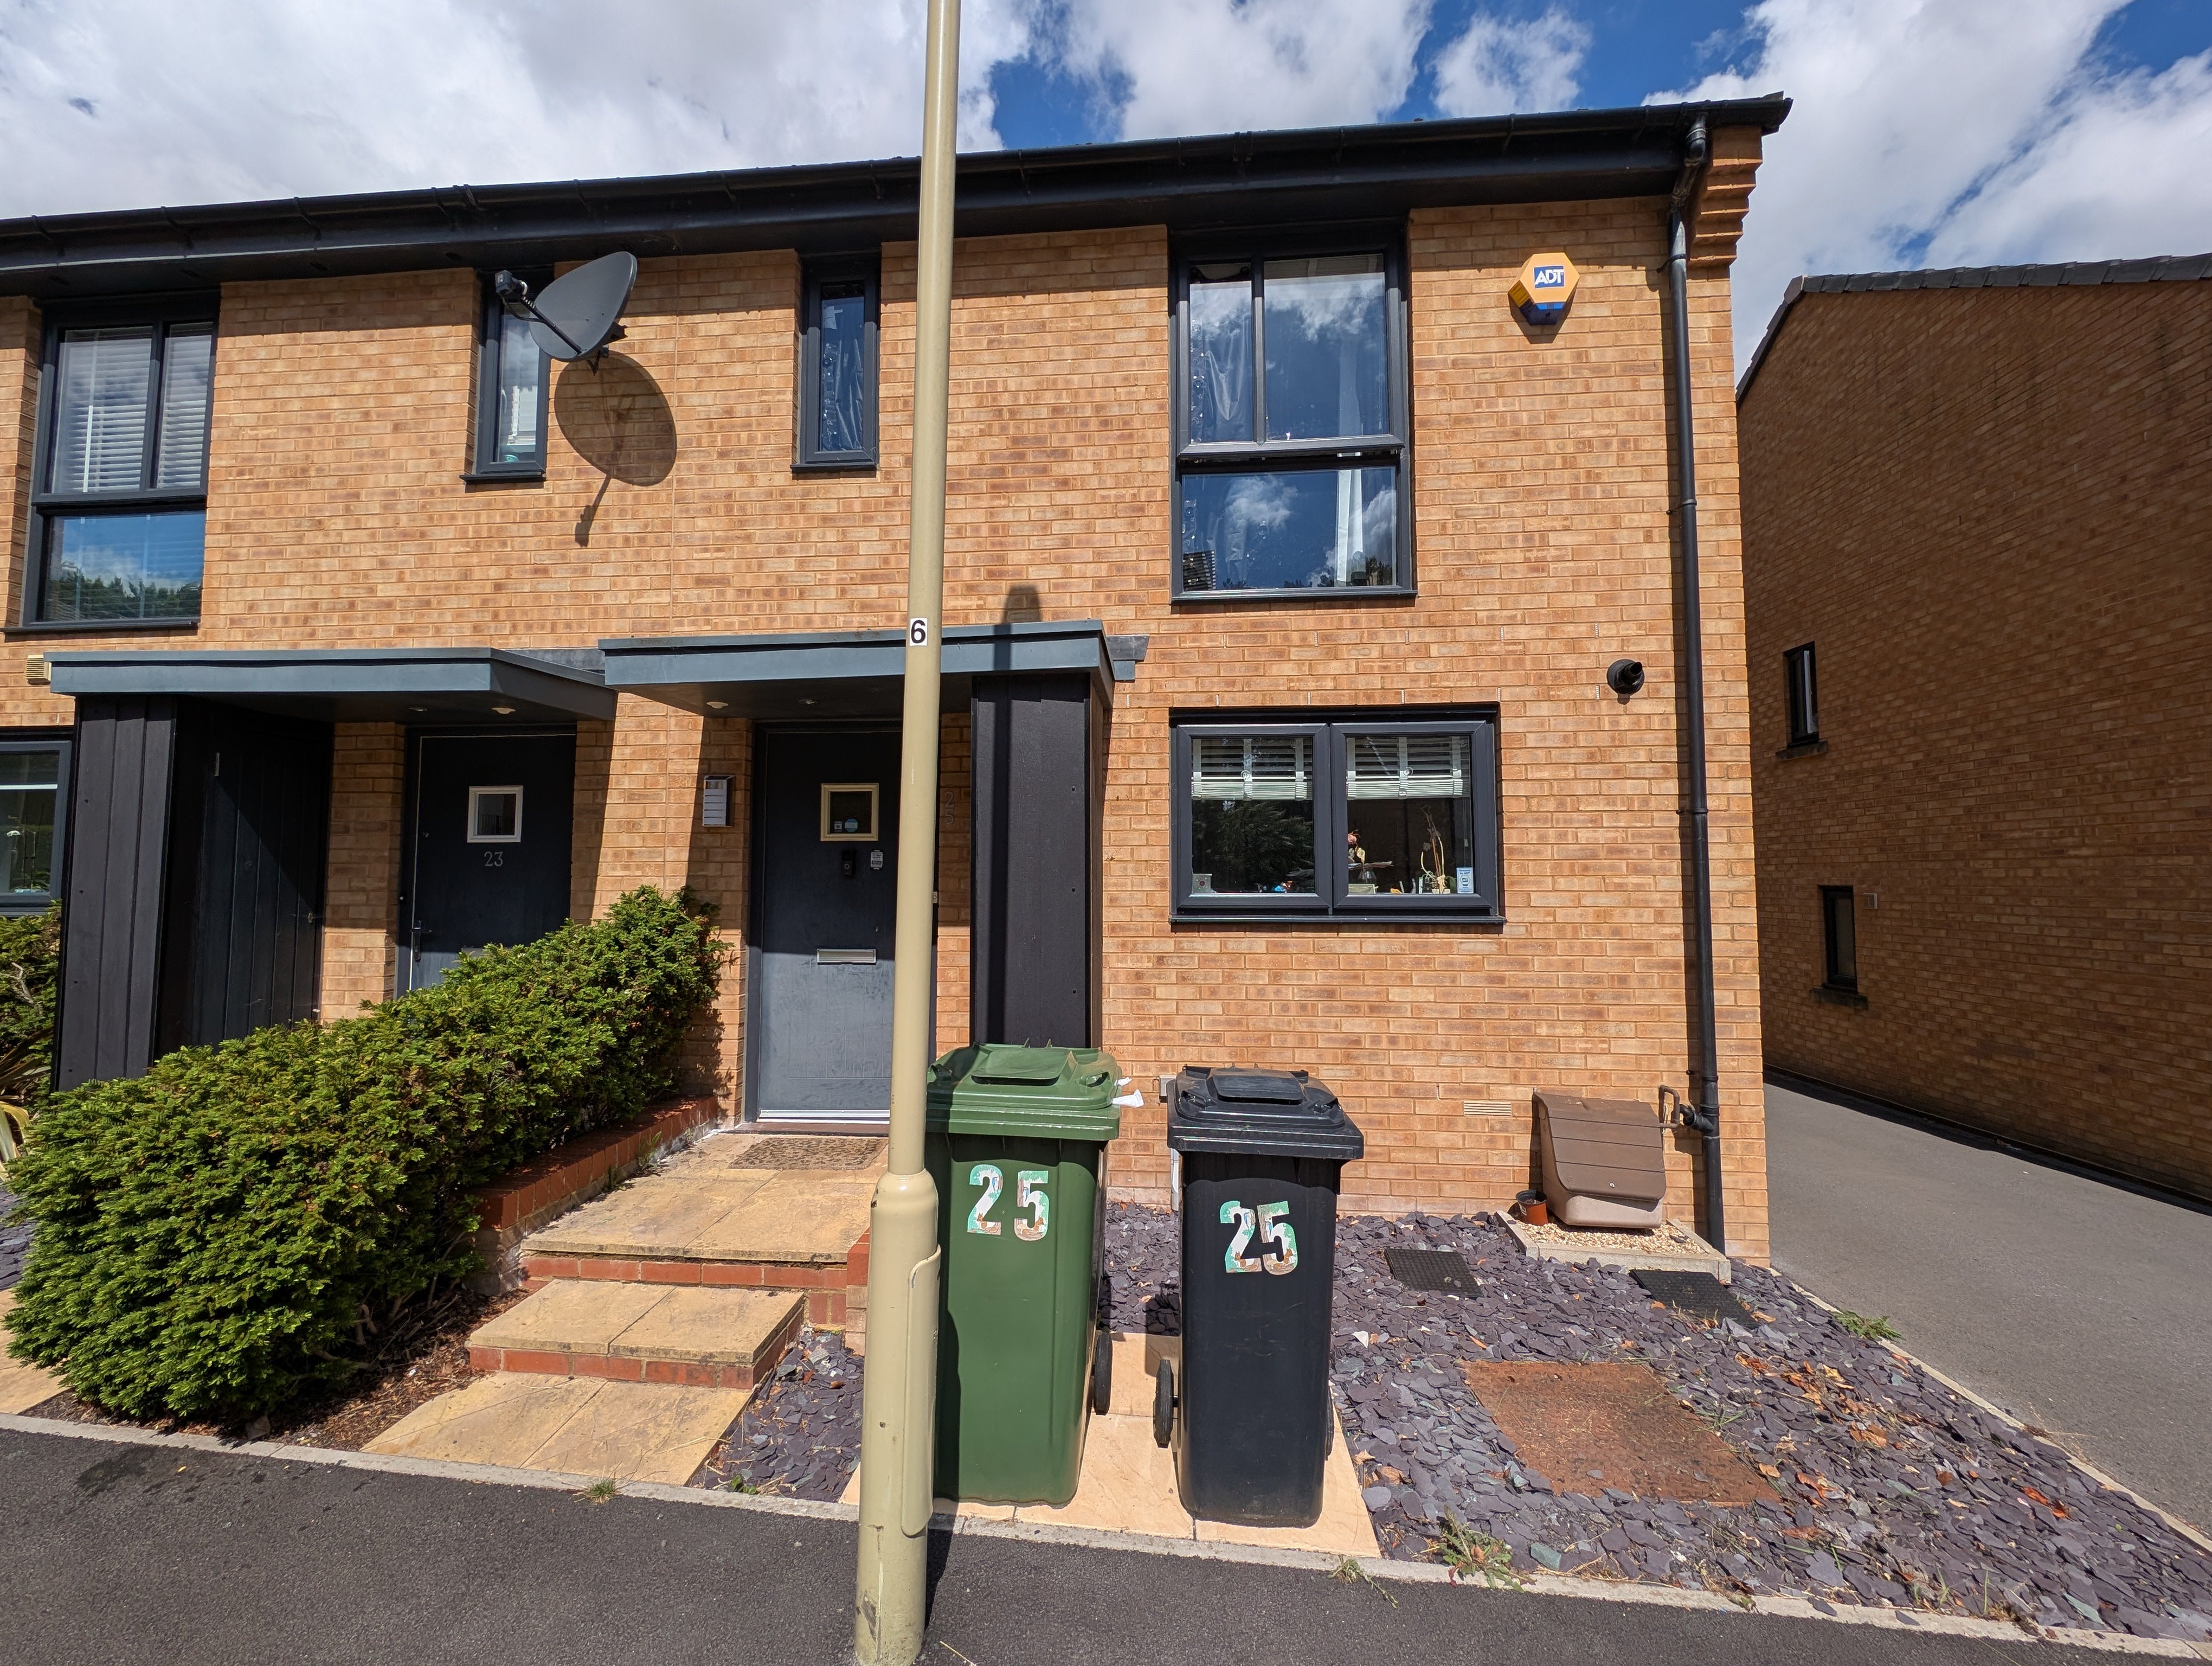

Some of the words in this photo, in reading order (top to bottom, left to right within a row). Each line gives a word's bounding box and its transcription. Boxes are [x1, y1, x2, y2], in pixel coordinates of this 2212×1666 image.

[1534, 269, 1565, 285] ADT
[911, 619, 926, 644] 6
[484, 851, 503, 867] 23
[967, 1164, 1050, 1241] 25
[1219, 1200, 1298, 1276] 25
